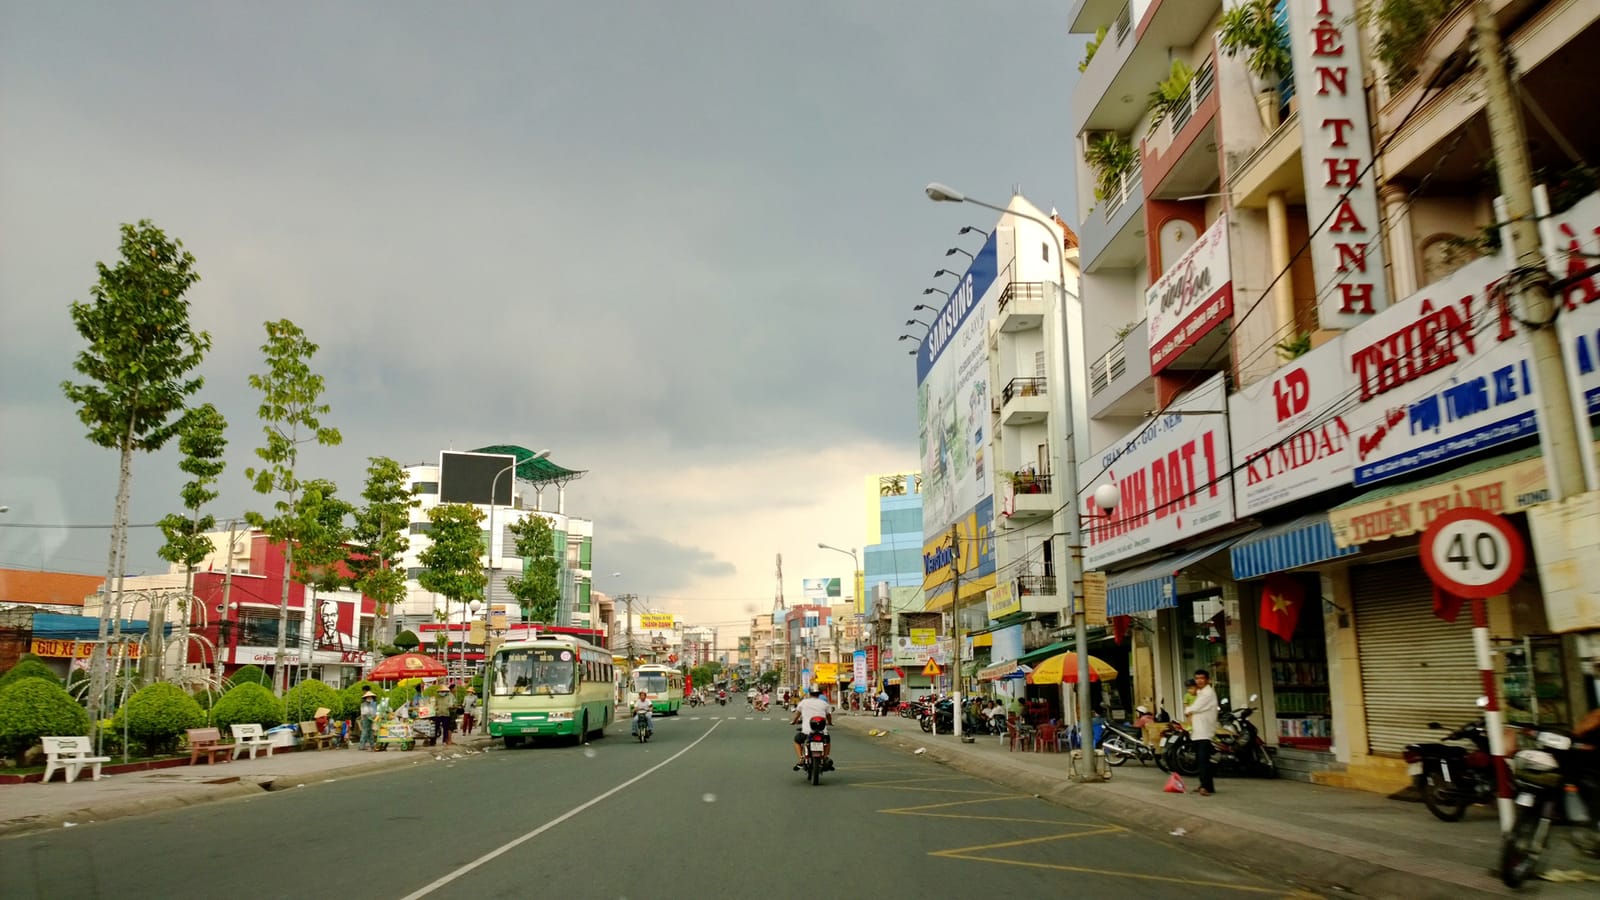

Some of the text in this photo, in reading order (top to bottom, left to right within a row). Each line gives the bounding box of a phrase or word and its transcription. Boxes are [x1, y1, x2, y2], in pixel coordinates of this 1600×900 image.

[1321, 119, 1376, 315] THÀNH
[928, 273, 973, 362] SAMSUNG
[1352, 295, 1477, 403] THIÊN
[1492, 363, 1518, 406] XE
[1151, 440, 1198, 531] ĐẠT
[1245, 415, 1351, 487] KYMDAN
[1351, 500, 1412, 541] THIÊN
[1447, 532, 1498, 570] 40
[340, 650, 368, 663] KFC
